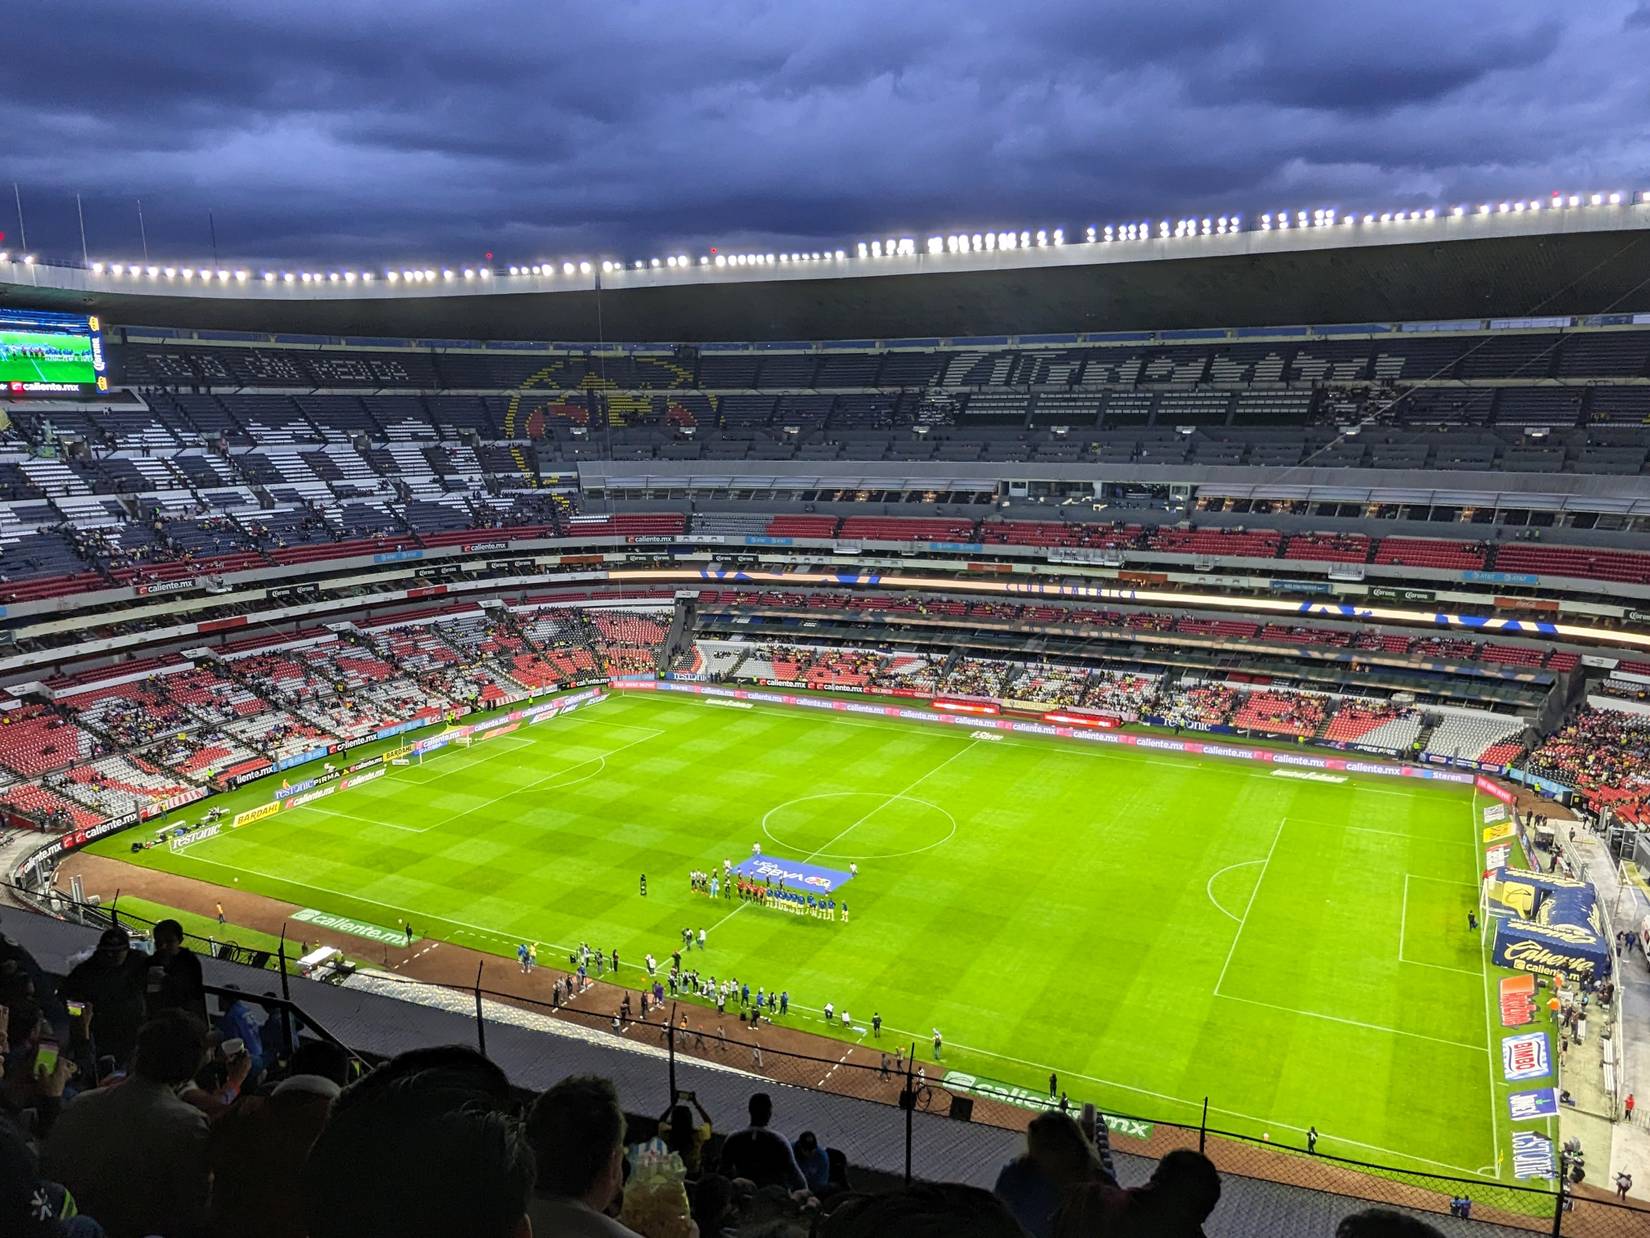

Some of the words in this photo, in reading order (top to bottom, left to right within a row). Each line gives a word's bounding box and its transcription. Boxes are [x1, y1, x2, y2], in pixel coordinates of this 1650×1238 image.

[23, 383, 80, 392] caliente.mx
[470, 544, 506, 552] caliente.mx
[148, 580, 193, 593] caliente.mx
[1005, 583, 1044, 593] CLUB
[1373, 588, 1395, 598] Corona
[1405, 591, 1428, 599] Corona
[1629, 611, 1650, 621] Coron
[767, 679, 806, 689] caliente.mx
[847, 703, 885, 714] caliente.mx
[899, 710, 939, 721] caliente.mx
[955, 717, 997, 728] caliente.mx
[1012, 724, 1055, 735] caliente.mx
[1073, 730, 1119, 743] caliente.mx
[1136, 738, 1184, 750] caliente.mx
[1357, 744, 1377, 753] FREE
[1203, 745, 1253, 759] caliente.mx
[355, 756, 384, 770] caliente.mx
[1273, 754, 1325, 768] caliente.mx
[236, 764, 275, 784] liente.mx
[1346, 761, 1400, 776] caliente.mx
[313, 771, 341, 787] PIRMA
[348, 767, 387, 786] caliente.mx
[1433, 771, 1461, 782] Steren
[293, 785, 336, 806] caliente.mx
[238, 803, 279, 824] BARDAHL
[85, 812, 138, 840] caliente.mx
[172, 824, 223, 849] restonic
[311, 914, 410, 945] caliente.mx
[1513, 1042, 1535, 1070] BIMBO
